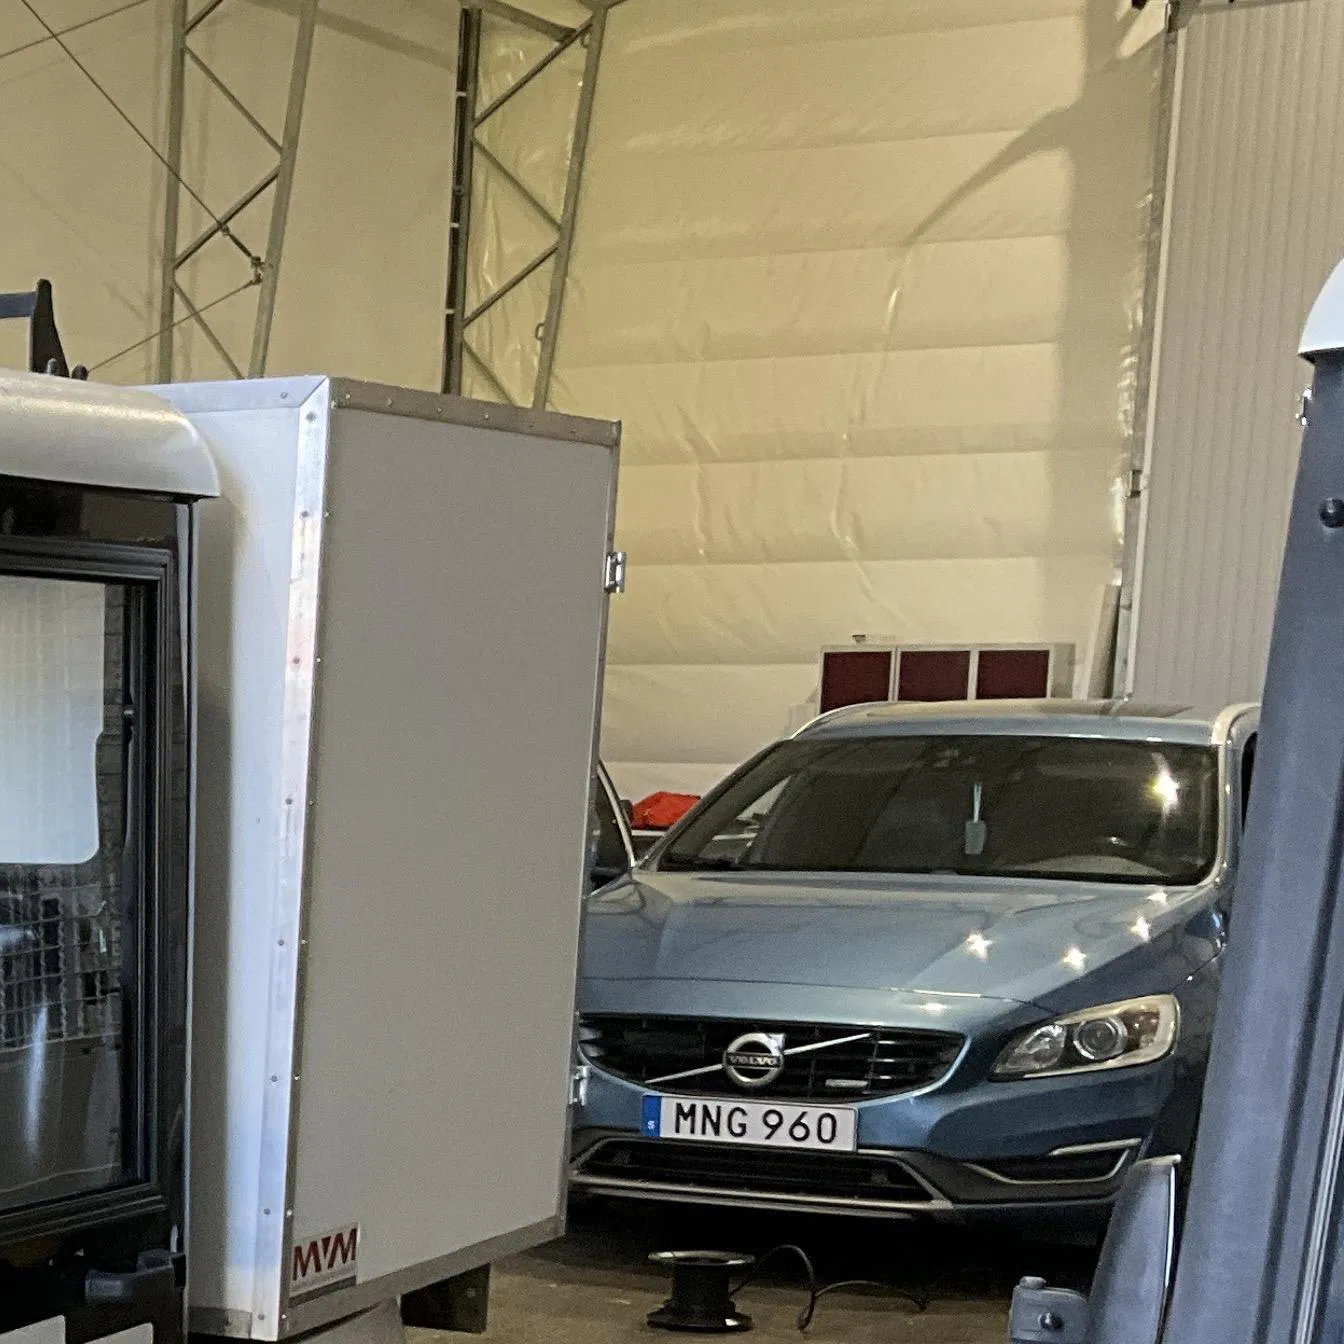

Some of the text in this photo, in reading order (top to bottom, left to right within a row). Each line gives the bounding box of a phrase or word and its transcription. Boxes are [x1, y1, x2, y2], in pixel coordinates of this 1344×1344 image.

[728, 1055, 778, 1067] VOLVO
[674, 1102, 748, 1138] MNG
[762, 1109, 838, 1144] 960
